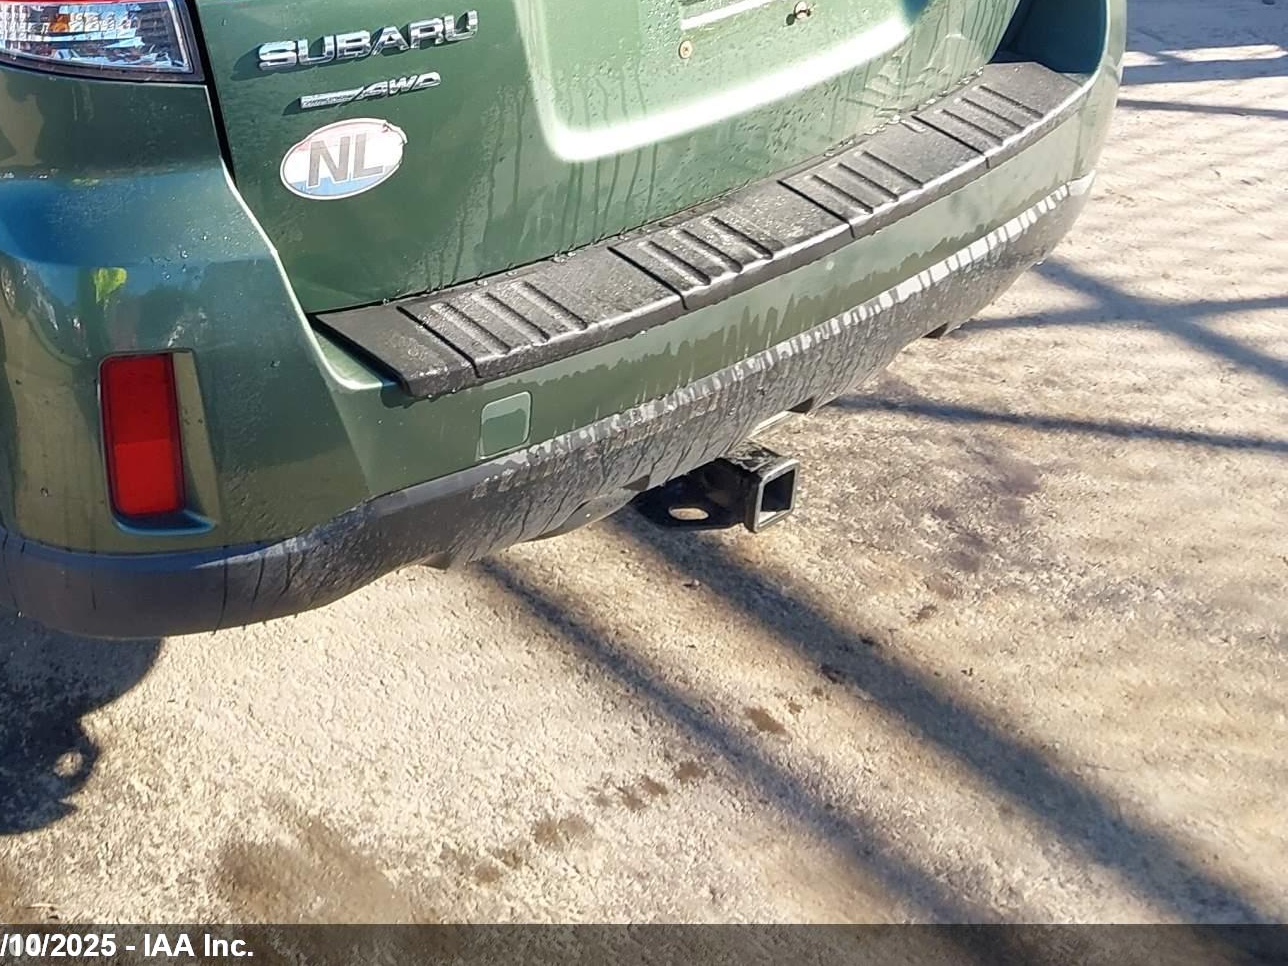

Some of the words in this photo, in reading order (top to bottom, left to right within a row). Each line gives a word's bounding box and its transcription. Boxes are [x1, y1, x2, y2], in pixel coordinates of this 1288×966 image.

[258, 9, 479, 70] SUBARU
[355, 72, 441, 101] AWD
[307, 132, 384, 187] NL
